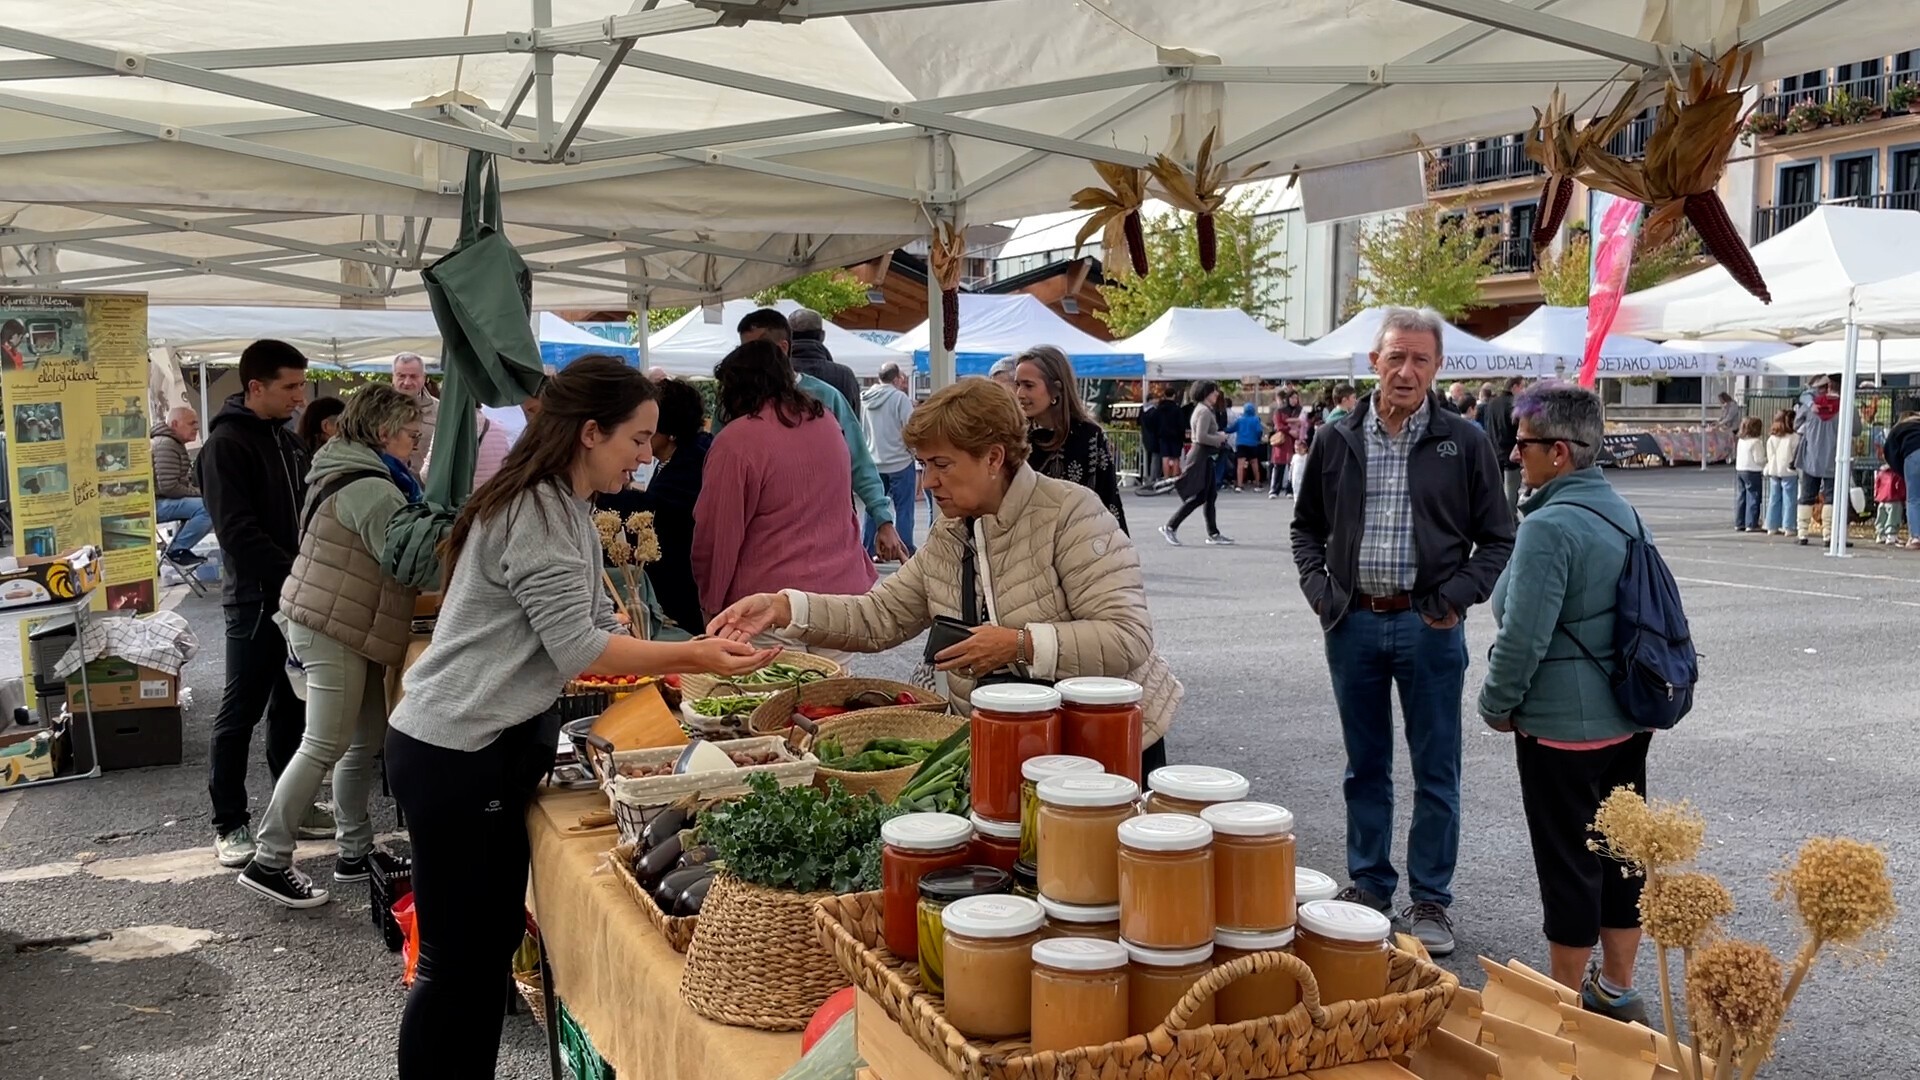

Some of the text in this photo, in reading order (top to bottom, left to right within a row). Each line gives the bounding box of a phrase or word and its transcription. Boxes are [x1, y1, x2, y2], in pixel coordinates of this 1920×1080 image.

[1486, 355, 1533, 370] UDALA
[1574, 355, 1699, 371] AOETAKO UDALA
